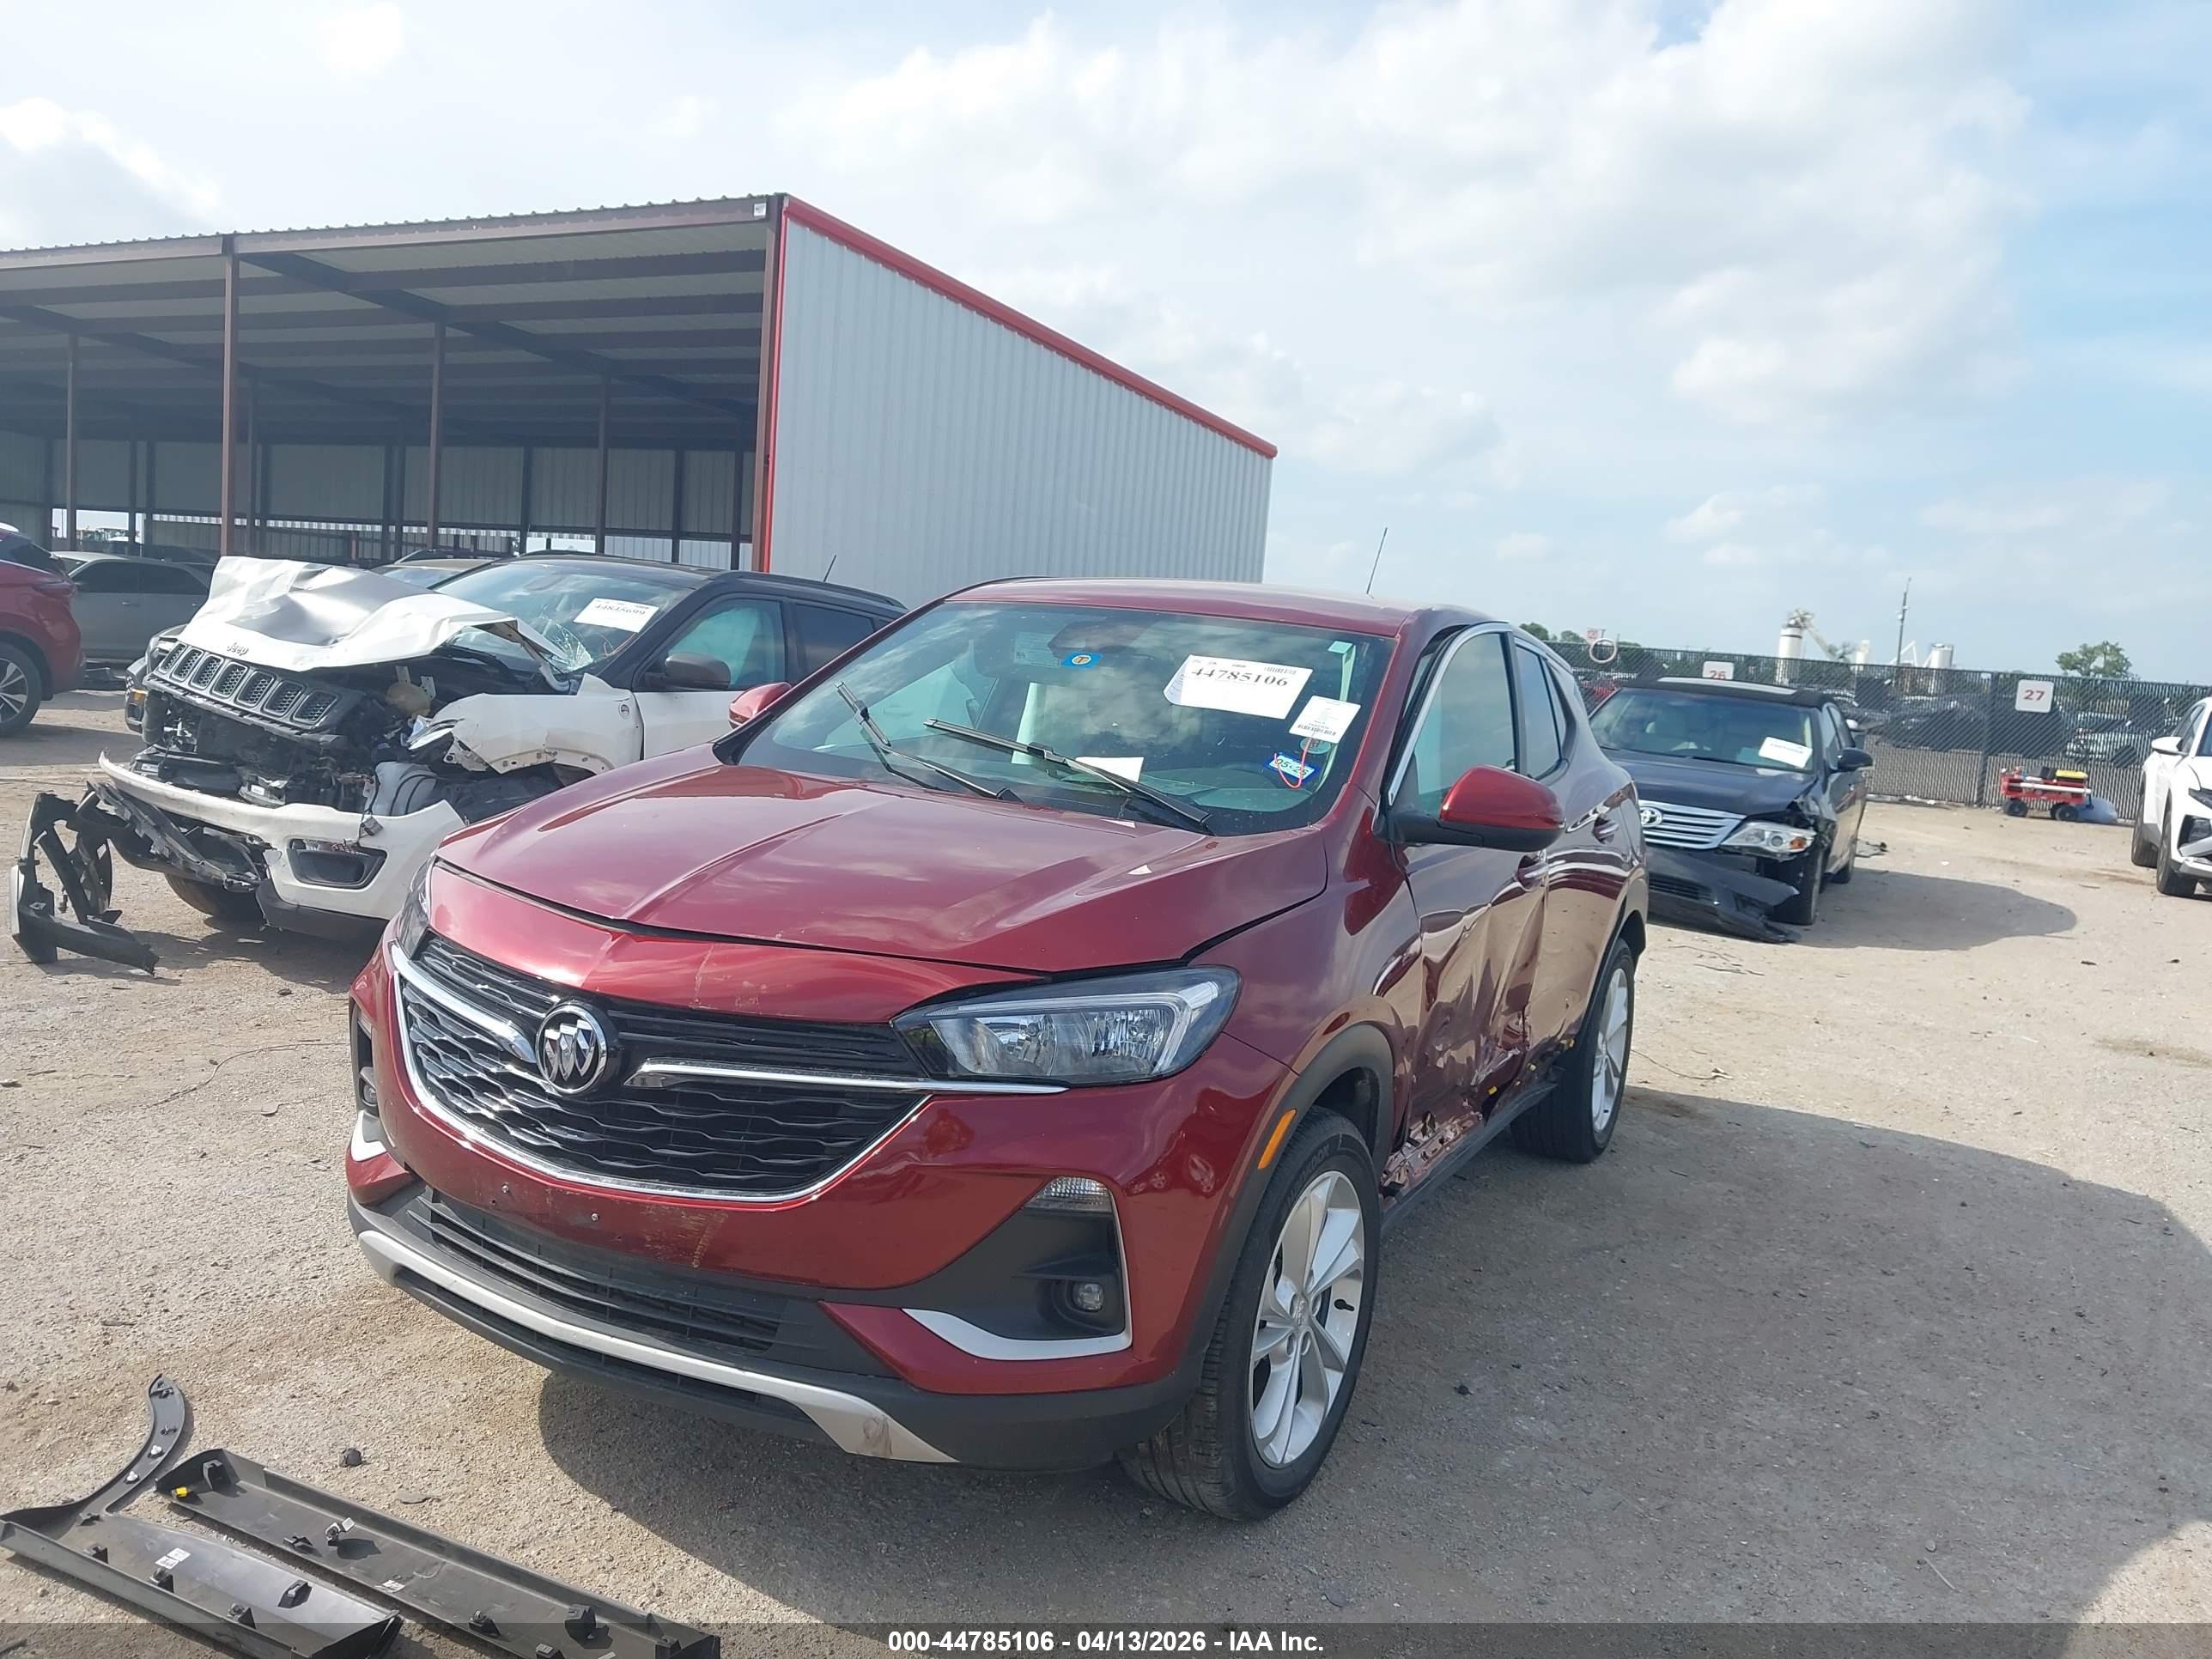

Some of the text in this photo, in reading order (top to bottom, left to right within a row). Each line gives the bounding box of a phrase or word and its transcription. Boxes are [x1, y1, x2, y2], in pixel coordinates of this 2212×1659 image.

[227, 642, 249, 656] Jeep
[1192, 667, 1288, 687] 44785106
[1710, 671, 1726, 679] 26
[2024, 690, 2045, 701] 27
